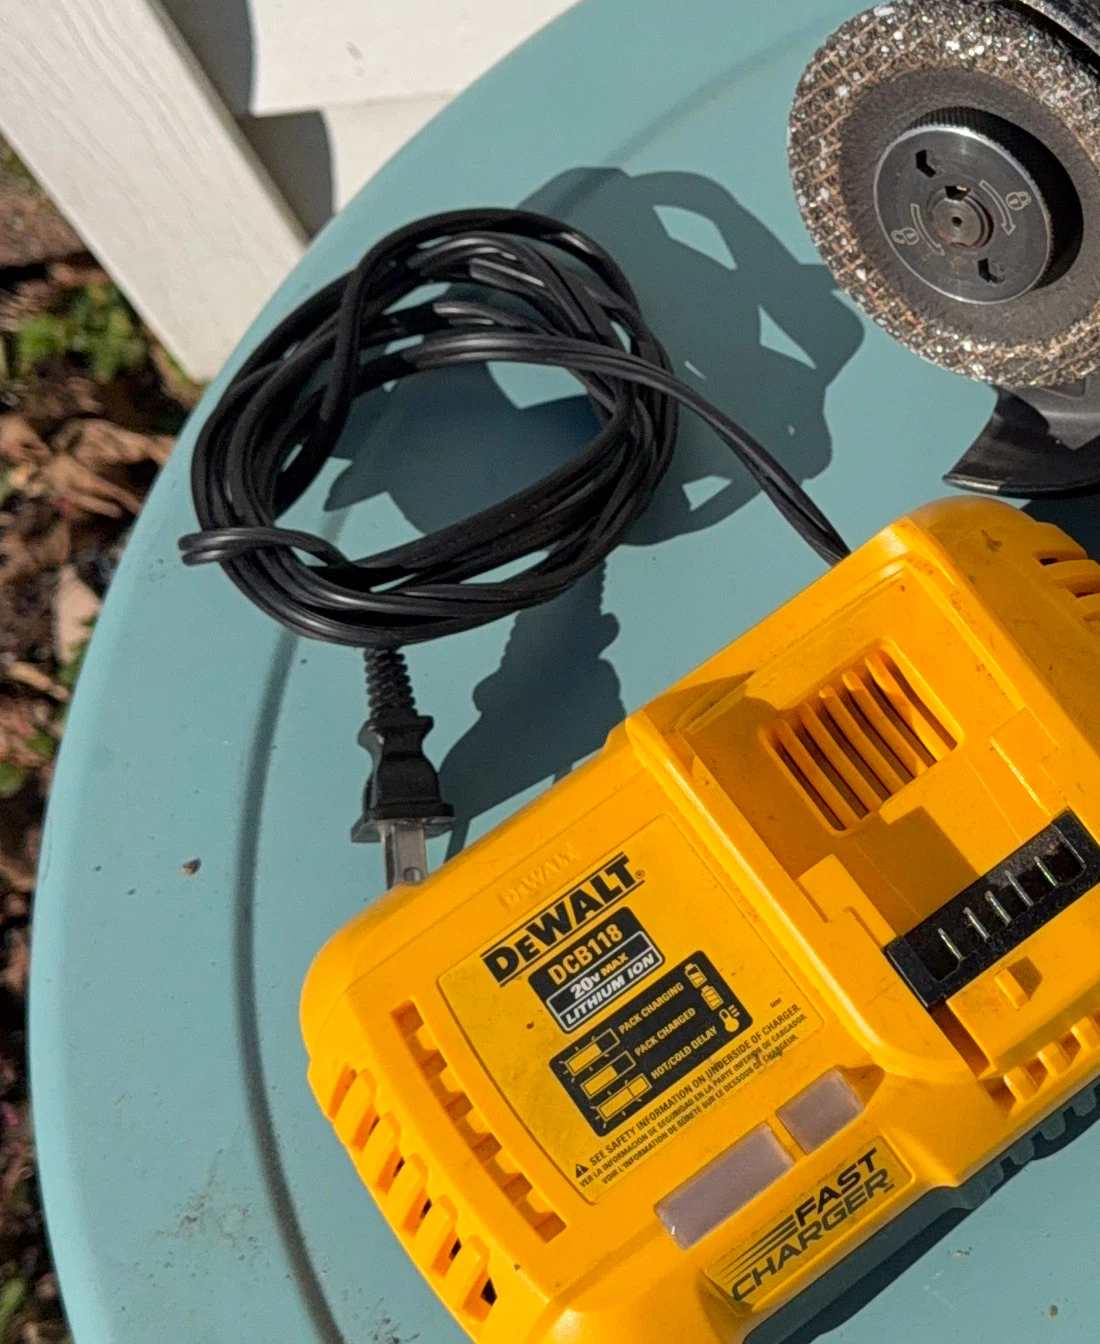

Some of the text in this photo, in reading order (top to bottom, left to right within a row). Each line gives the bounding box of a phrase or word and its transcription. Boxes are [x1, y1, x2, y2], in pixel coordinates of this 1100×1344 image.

[546, 922, 624, 985] DCB118
[565, 952, 653, 1025] LITHIUM ION
[599, 952, 629, 976] MAX
[617, 981, 684, 1034] PACK CHARGING
[633, 1006, 697, 1057] PACK CHARGED
[649, 1025, 719, 1080] HOT/COLD DELAY
[578, 1174, 594, 1188] VER
[592, 1167, 603, 1177] LA
[646, 1125, 658, 1136] DE
[656, 1097, 695, 1129] SEGURIDAD
[693, 1090, 705, 1101] EN
[702, 1083, 714, 1094] LA
[711, 1068, 733, 1087] PARTE
[760, 1039, 772, 1050] DE
[769, 1013, 806, 1042] CARGADOR
[588, 1149, 607, 1166] SEE
[604, 1126, 637, 1154] SAFETY
[635, 1084, 693, 1131] INFORMATION
[691, 1074, 706, 1088] ON
[704, 1039, 752, 1078] UNDERSIDE
[749, 1031, 763, 1044] OF
[601, 1168, 619, 1184] VOIR
[617, 1130, 668, 1172] L'INFORMATION
[667, 1123, 678, 1134] DE
[700, 1094, 716, 1109] SUR
[714, 1088, 725, 1098] LE
[722, 1065, 754, 1092] DESSOUS
[794, 1147, 877, 1227] FAST
[731, 1167, 888, 1302] CHARGER
